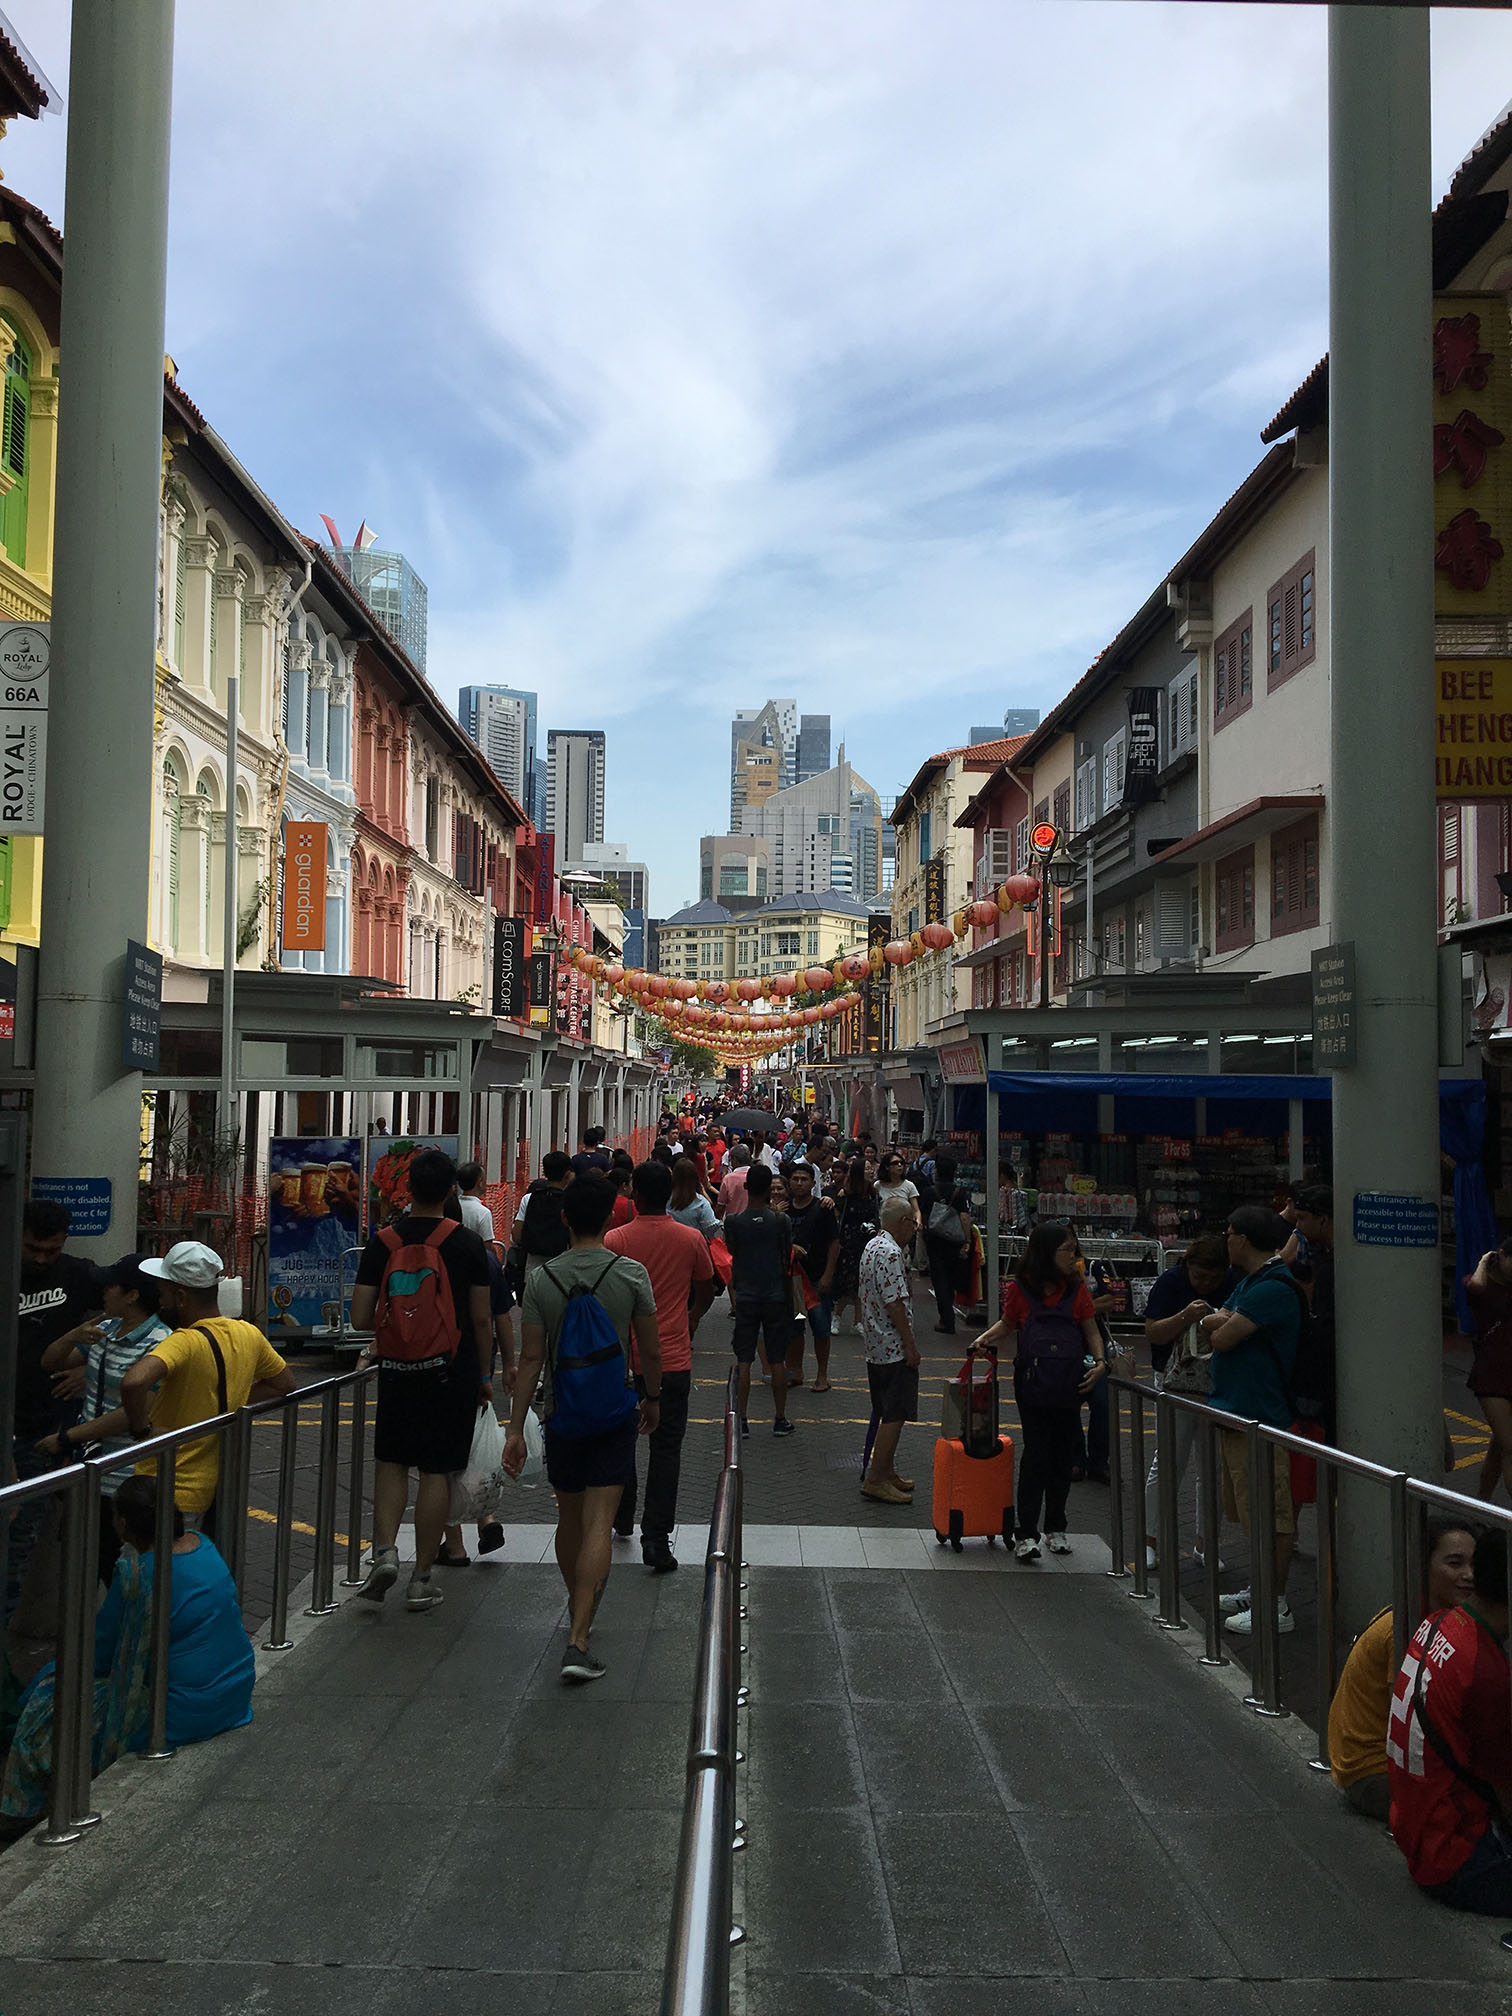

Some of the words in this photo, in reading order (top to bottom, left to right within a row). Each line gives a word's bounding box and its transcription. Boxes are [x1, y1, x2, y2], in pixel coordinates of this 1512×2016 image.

[4, 653, 43, 662] ROYAL
[1441, 671, 1494, 700] BEE
[5, 687, 40, 702] 66A
[1131, 713, 1156, 742] 5
[1438, 712, 1512, 743] HENG
[28, 725, 38, 782] CHINATOWN
[3, 725, 26, 822] ROYAL
[1436, 756, 1512, 786] IANG
[27, 790, 36, 822] LODGE
[294, 853, 314, 937] guardian
[570, 1006, 578, 1035] CENTRE
[75, 1183, 89, 1191] not
[63, 1196, 76, 1204] the
[72, 1210, 89, 1218] ance
[96, 1209, 108, 1217] for
[1395, 1209, 1404, 1217] to
[1405, 1209, 1417, 1218] the
[1382, 1222, 1396, 1231] use
[1394, 1236, 1402, 1244] to
[281, 1259, 304, 1271] JUG
[287, 1274, 315, 1284] HAPPY
[381, 1356, 446, 1372] DICKIES
